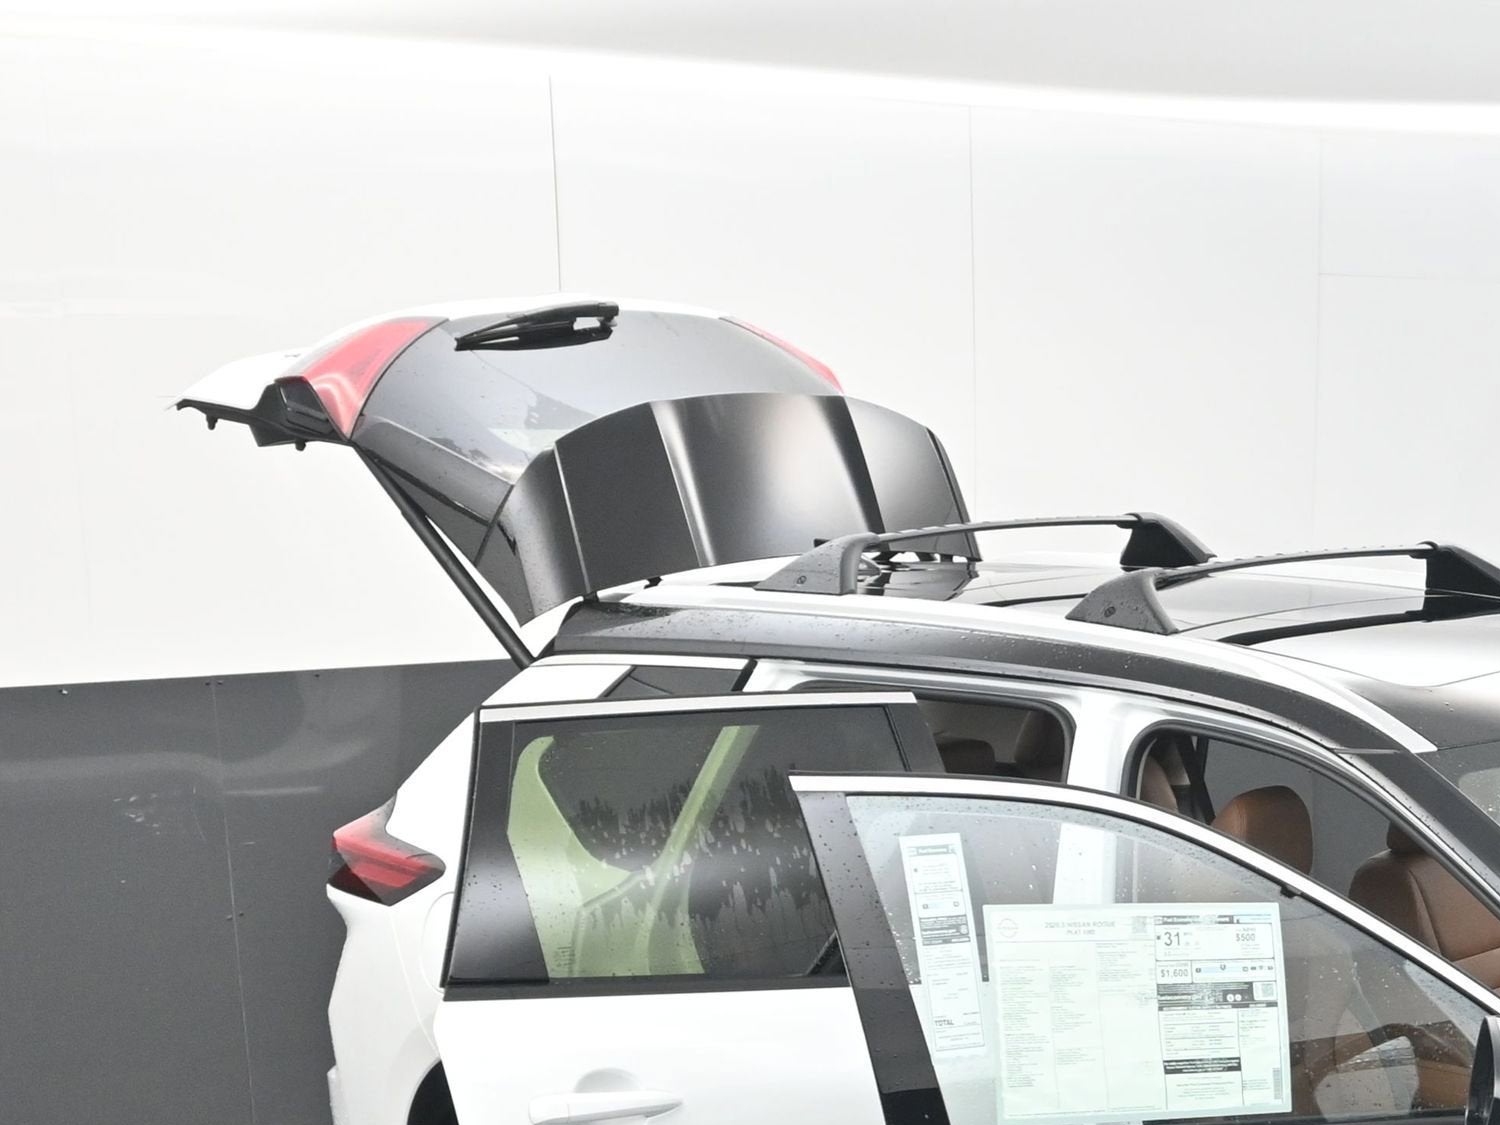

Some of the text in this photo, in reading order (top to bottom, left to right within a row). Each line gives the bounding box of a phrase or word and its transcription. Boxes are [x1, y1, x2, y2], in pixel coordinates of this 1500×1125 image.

[1092, 920, 1116, 928] ROGUE
[1163, 931, 1181, 947] 31
[1235, 932, 1256, 942] $500
[1160, 968, 1189, 979] $1,600
[934, 1018, 955, 1027] TOTAL
